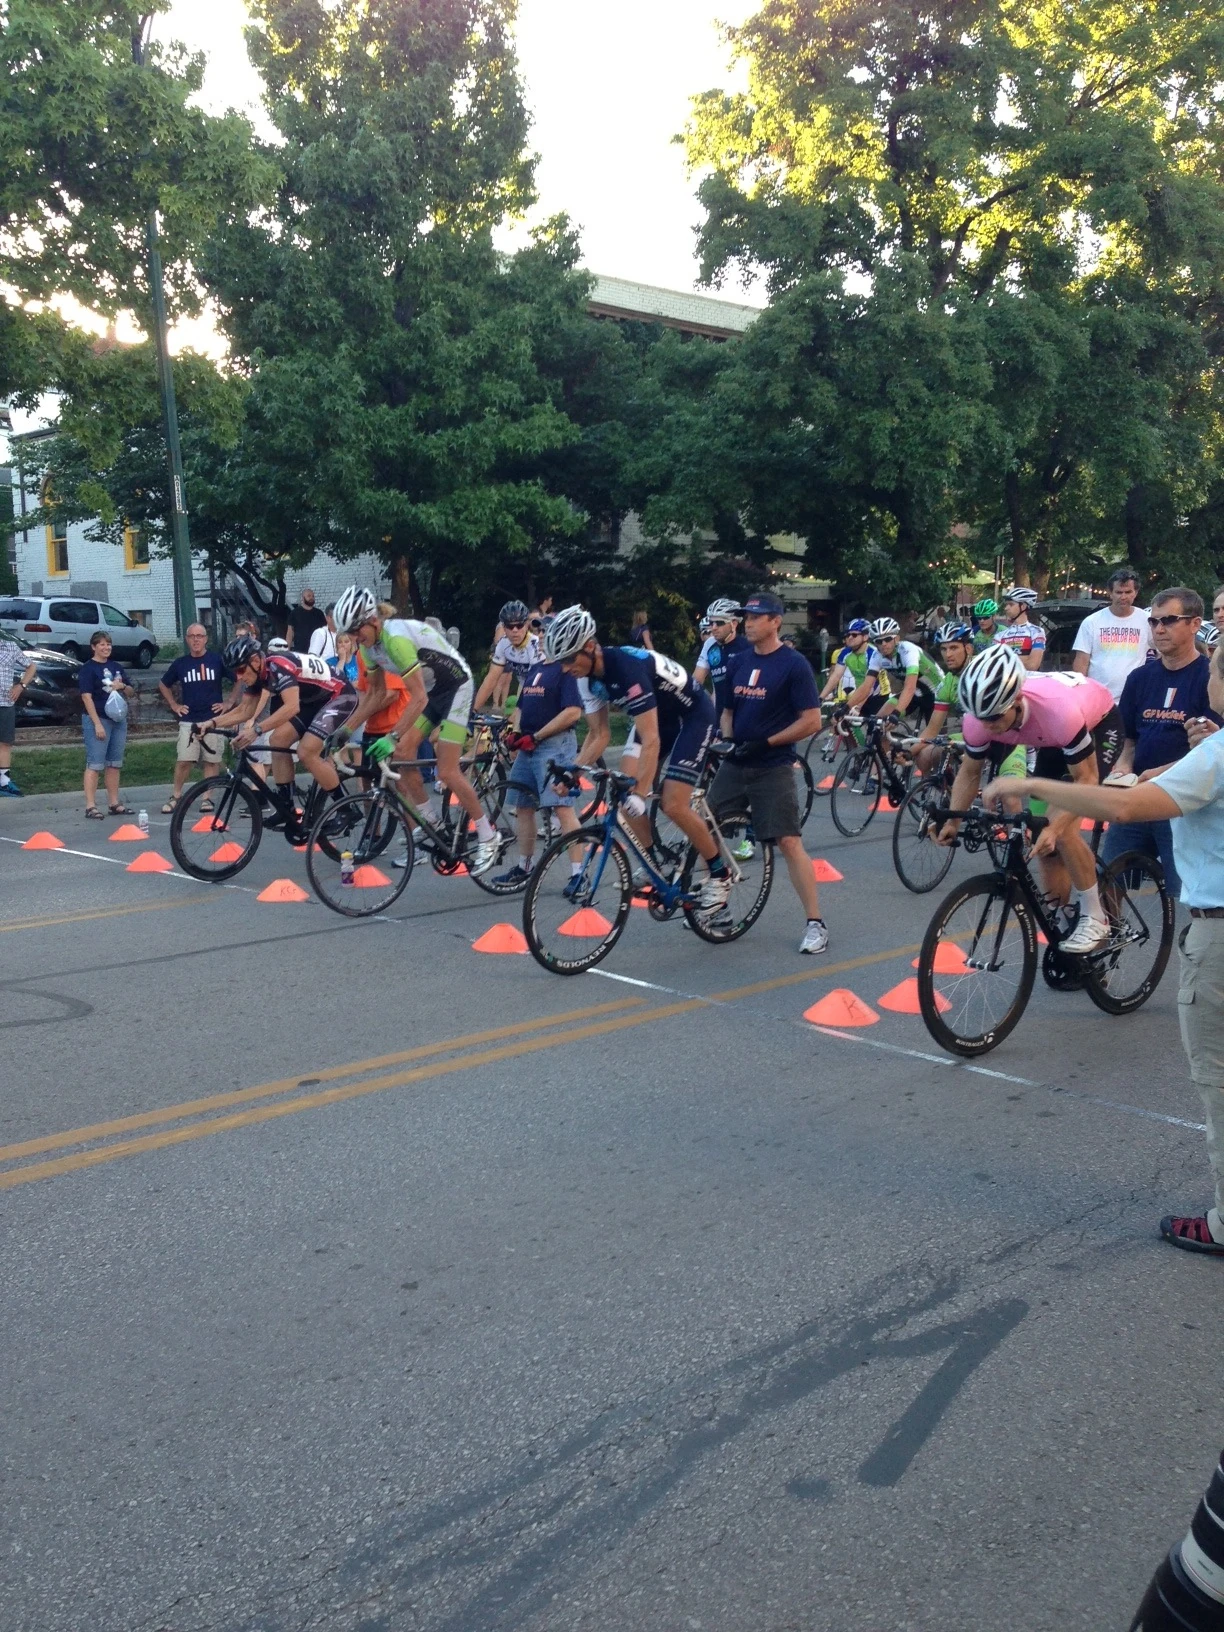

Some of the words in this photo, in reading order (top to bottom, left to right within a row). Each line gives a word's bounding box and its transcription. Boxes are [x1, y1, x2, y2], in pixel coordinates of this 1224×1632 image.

[1100, 627, 1110, 636] THE
[1111, 627, 1129, 636] COLOR
[1130, 627, 1141, 637] RUN
[1100, 635, 1110, 643] THE
[308, 658, 324, 675] 40
[746, 864, 771, 922] REYNOLDS
[556, 944, 607, 969] REYNOLDS
